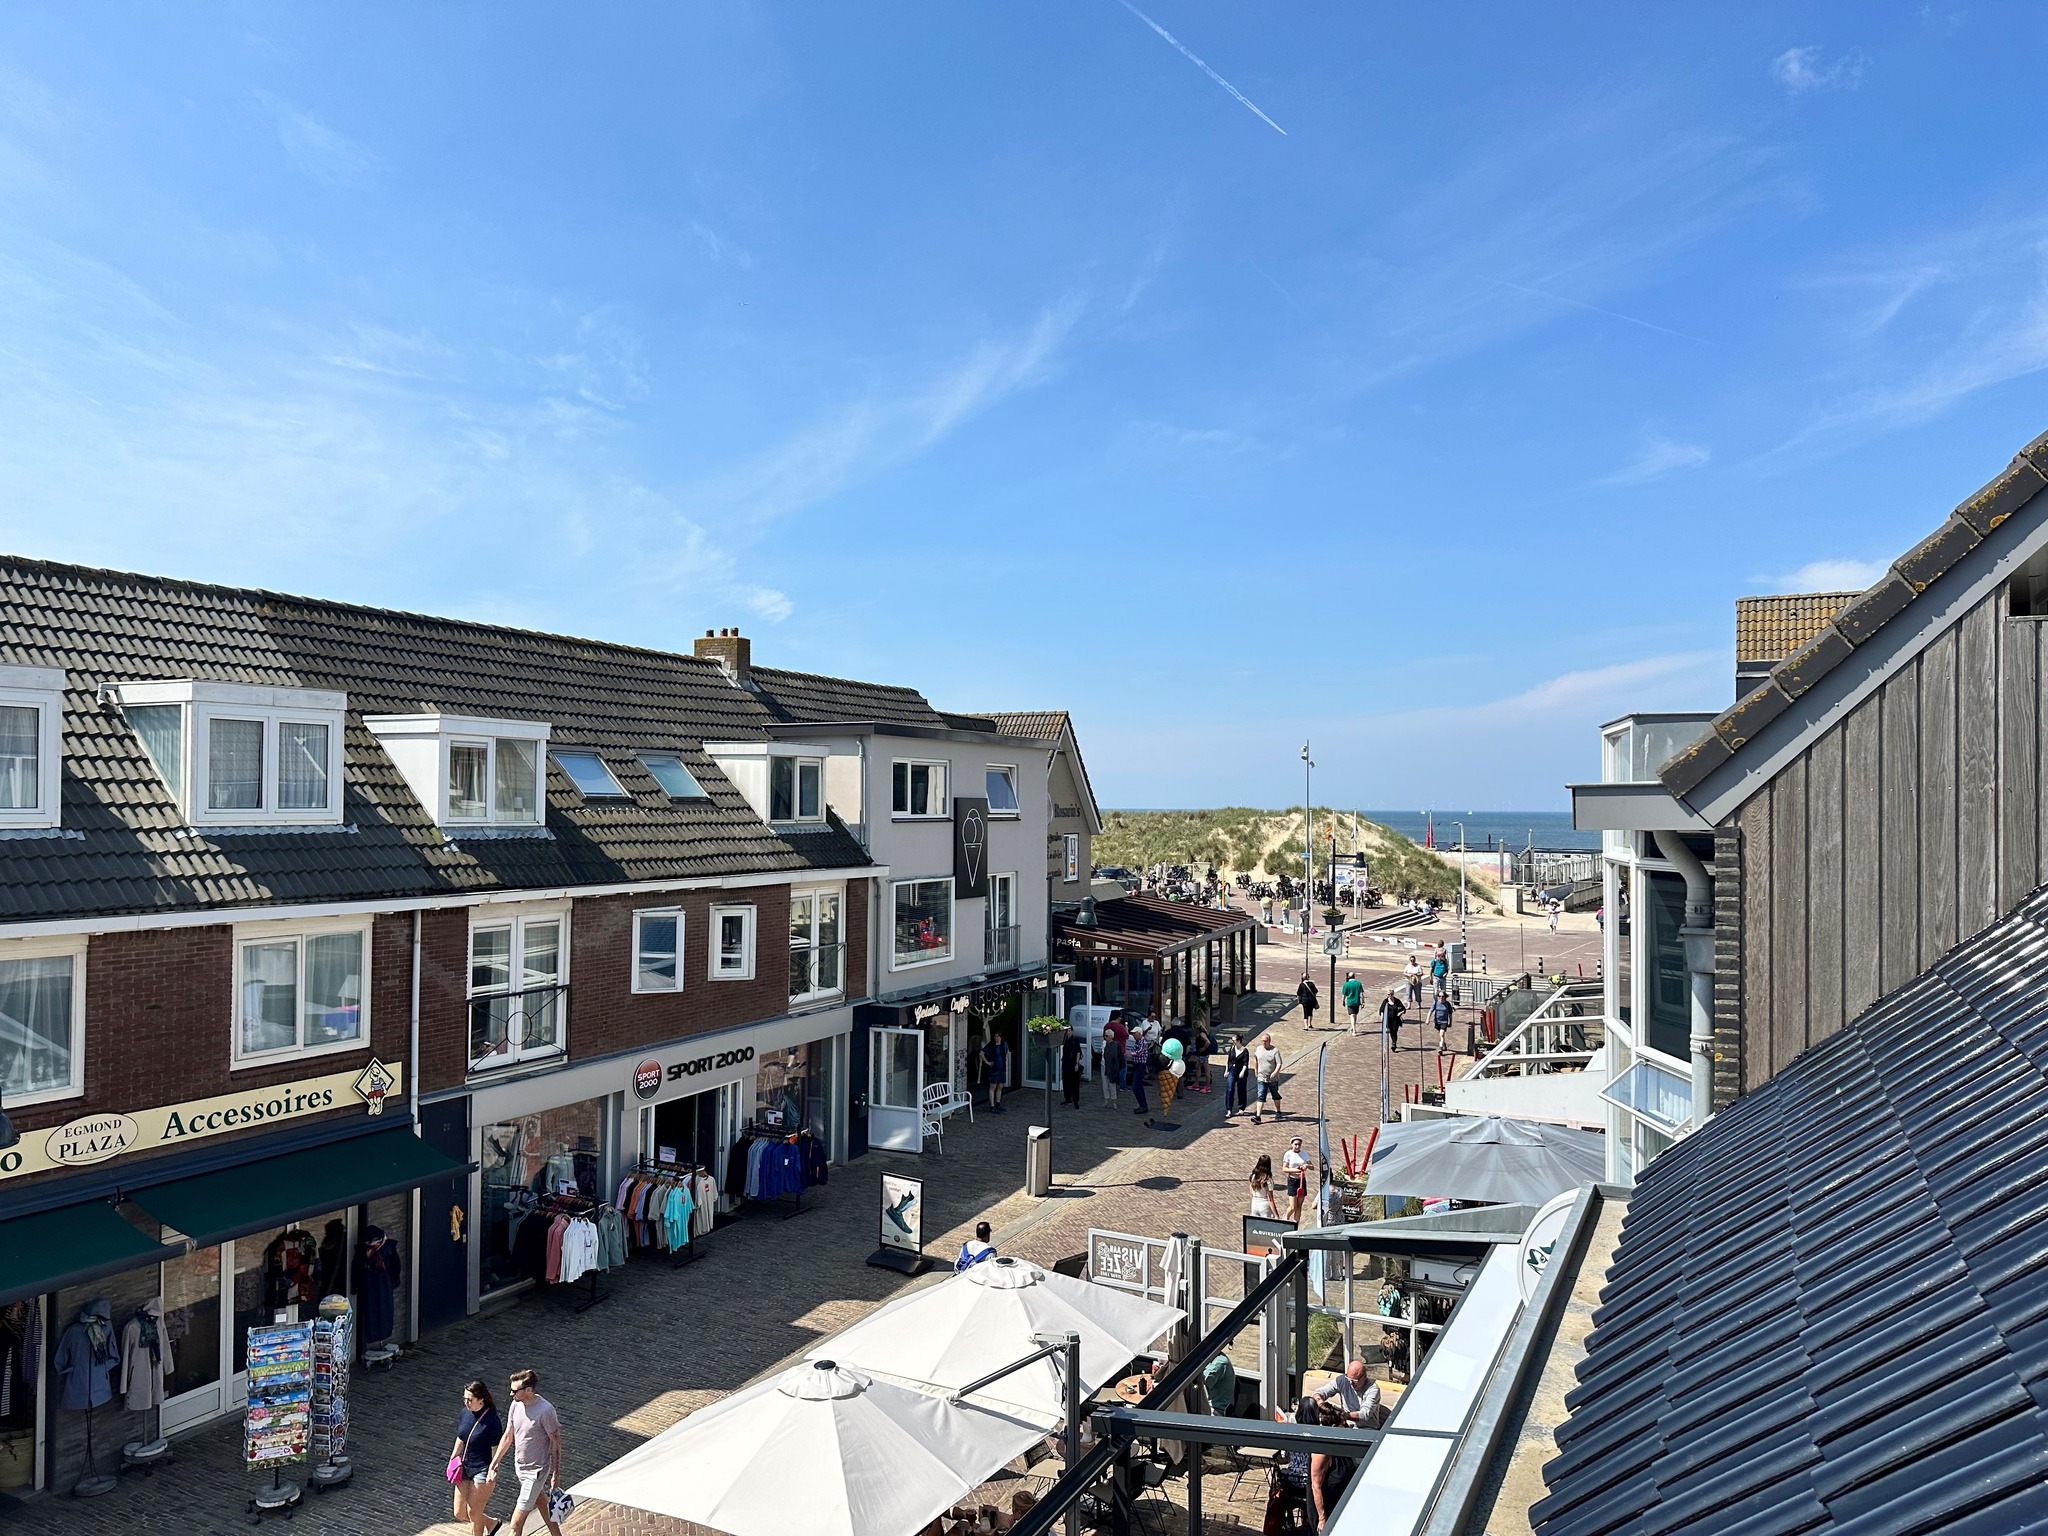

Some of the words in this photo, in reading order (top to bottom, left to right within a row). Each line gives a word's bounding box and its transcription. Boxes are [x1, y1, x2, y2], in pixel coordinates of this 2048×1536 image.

[914, 1003, 941, 1026] Gelato
[637, 1069, 661, 1082] SPORT
[667, 1056, 716, 1082] SPORT
[716, 1046, 755, 1069] 2000
[639, 1078, 658, 1090] 2000
[160, 1087, 334, 1141] Accessoires
[64, 1118, 122, 1139] EGMOND
[58, 1132, 127, 1160] PLAZA
